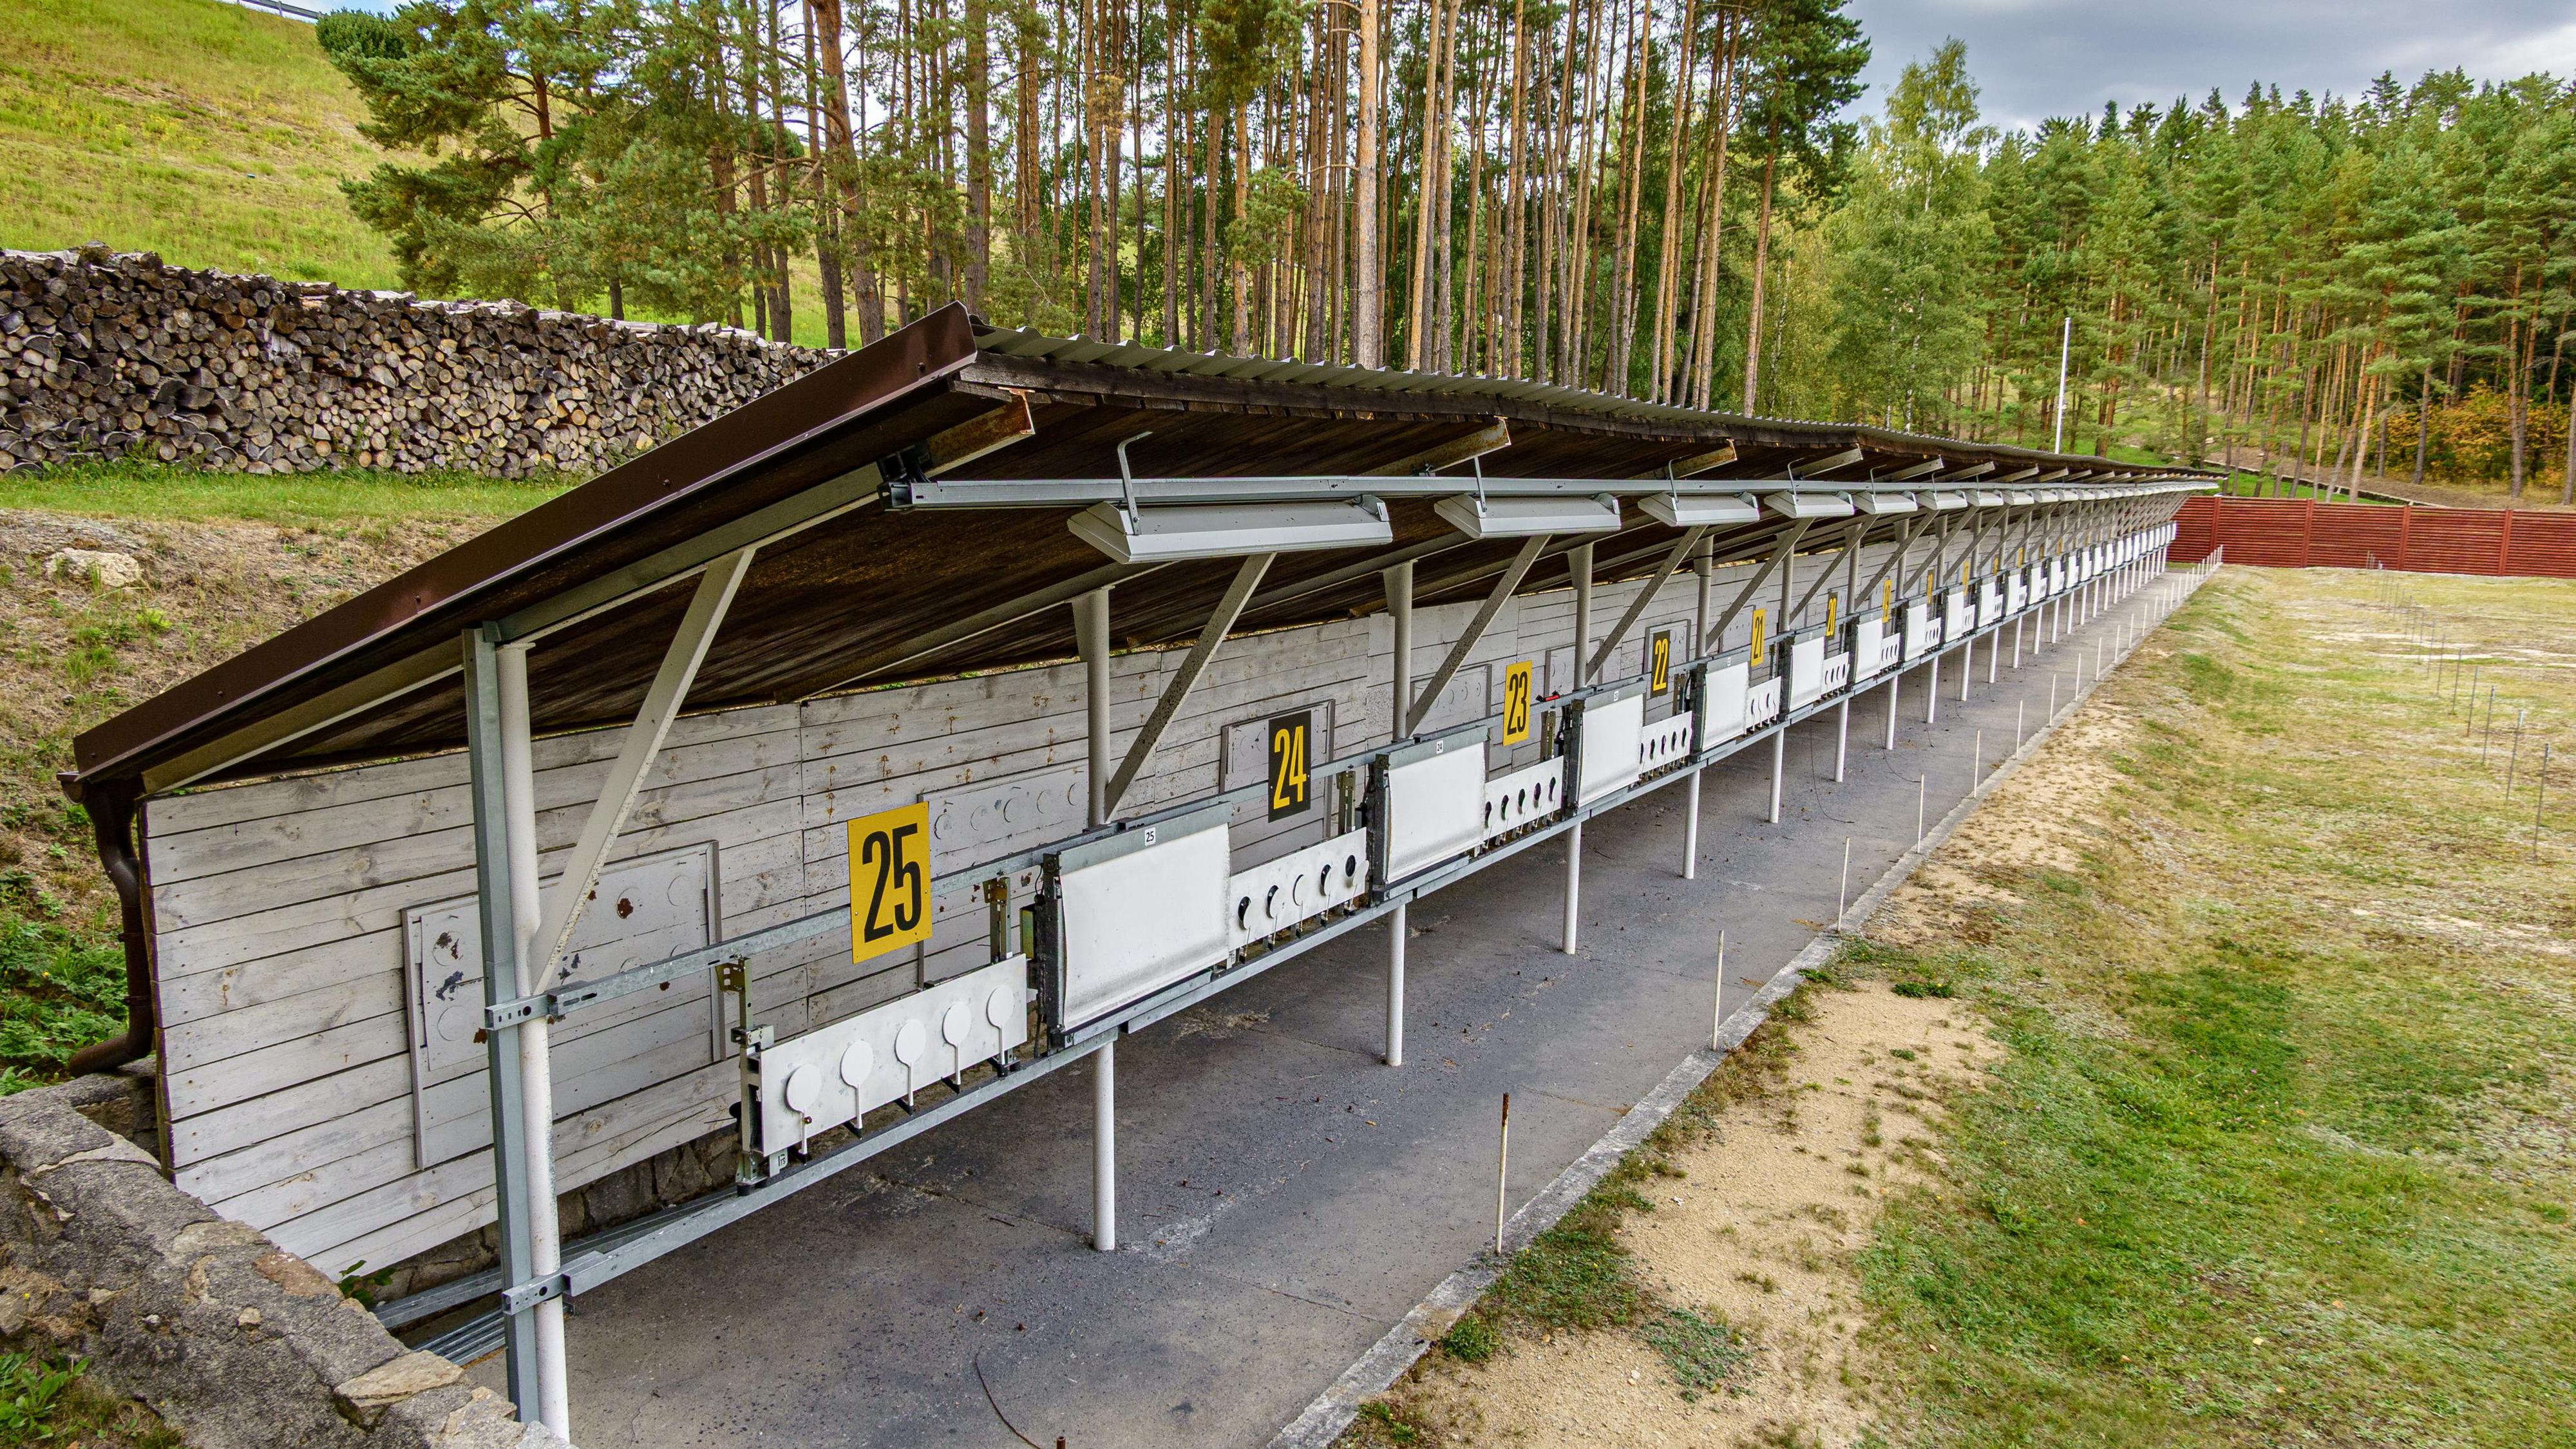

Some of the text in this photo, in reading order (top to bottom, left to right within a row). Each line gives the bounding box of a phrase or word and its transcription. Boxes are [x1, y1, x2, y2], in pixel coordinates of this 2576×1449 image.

[1754, 616, 1763, 659] 21
[1826, 598, 1836, 636] 20
[1653, 639, 1668, 691] 22
[1507, 671, 1528, 735] 23
[1273, 725, 1307, 810] 24
[1146, 831, 1154, 842] 25
[862, 822, 922, 943] 25
